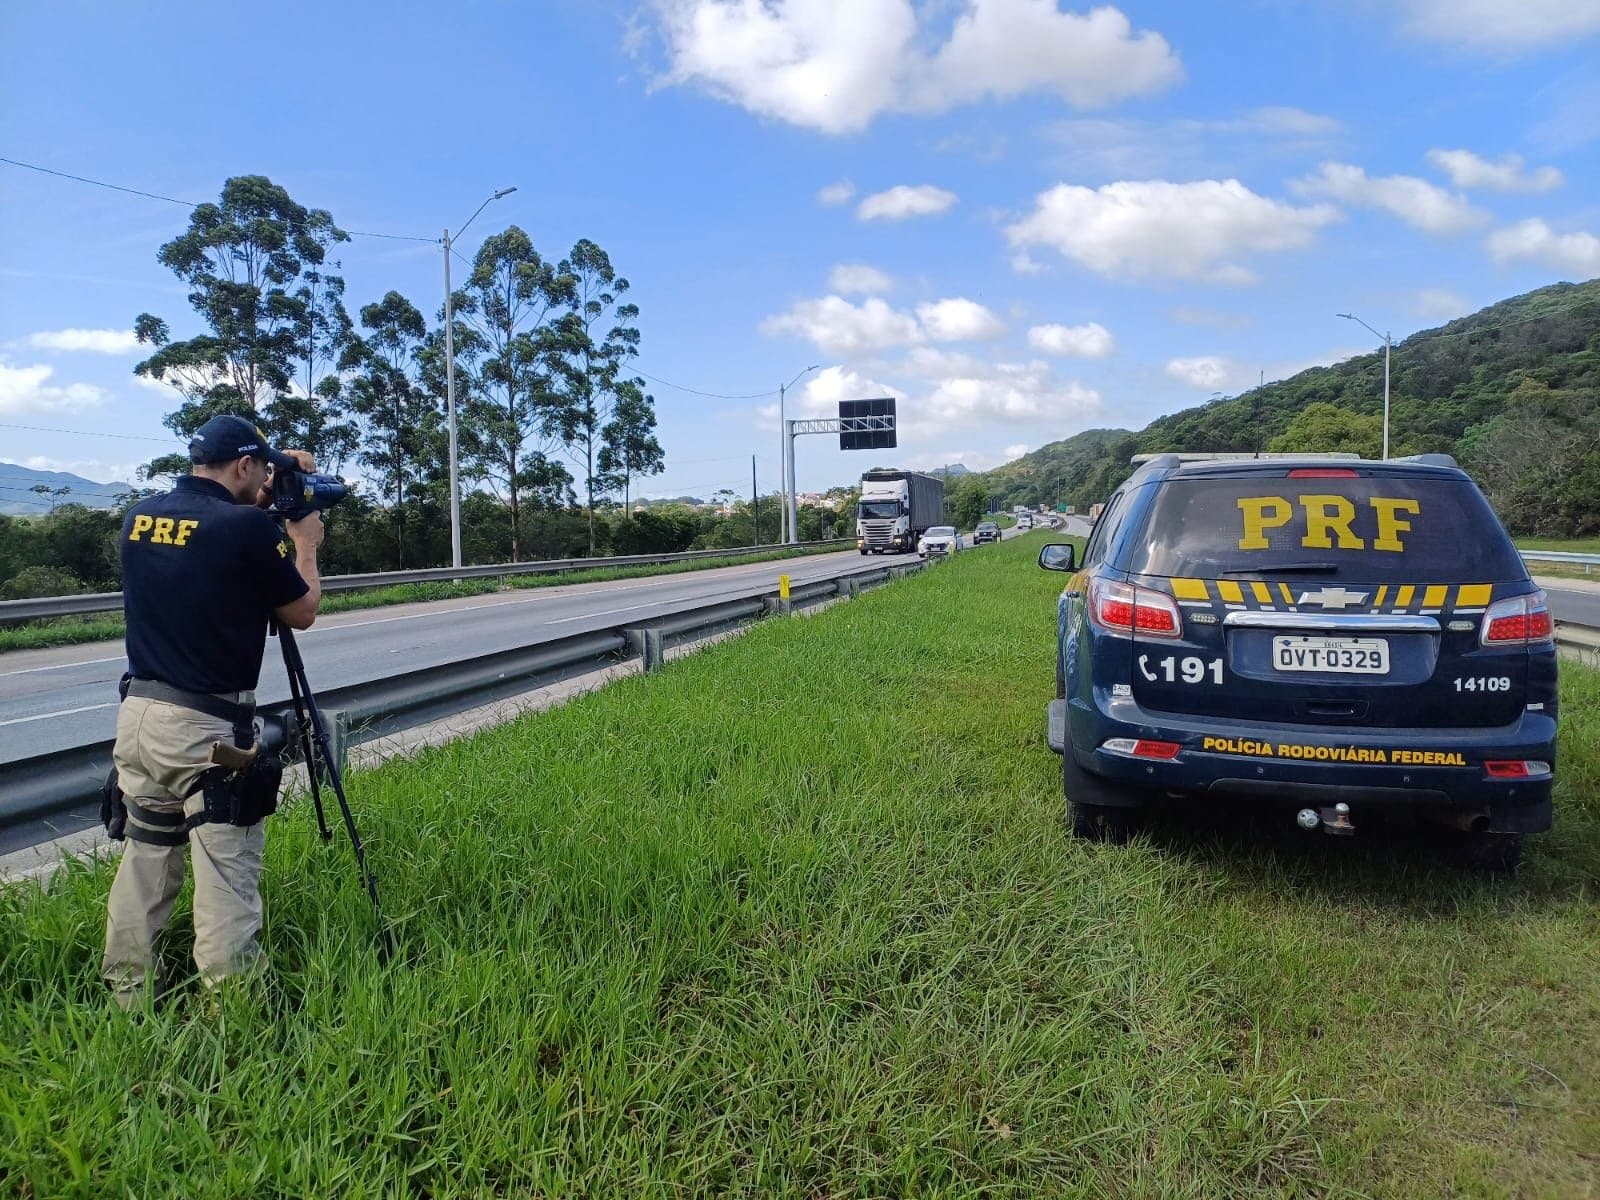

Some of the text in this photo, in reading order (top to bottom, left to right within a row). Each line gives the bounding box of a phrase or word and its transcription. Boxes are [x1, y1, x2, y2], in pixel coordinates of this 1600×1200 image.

[128, 514, 199, 546] PRF
[1237, 494, 1420, 552] PRF
[1160, 656, 1224, 684] 191
[1453, 677, 1511, 692] 14109
[1203, 736, 1466, 767] POLÍCIA RODOVIÁRIA FEDERAL
